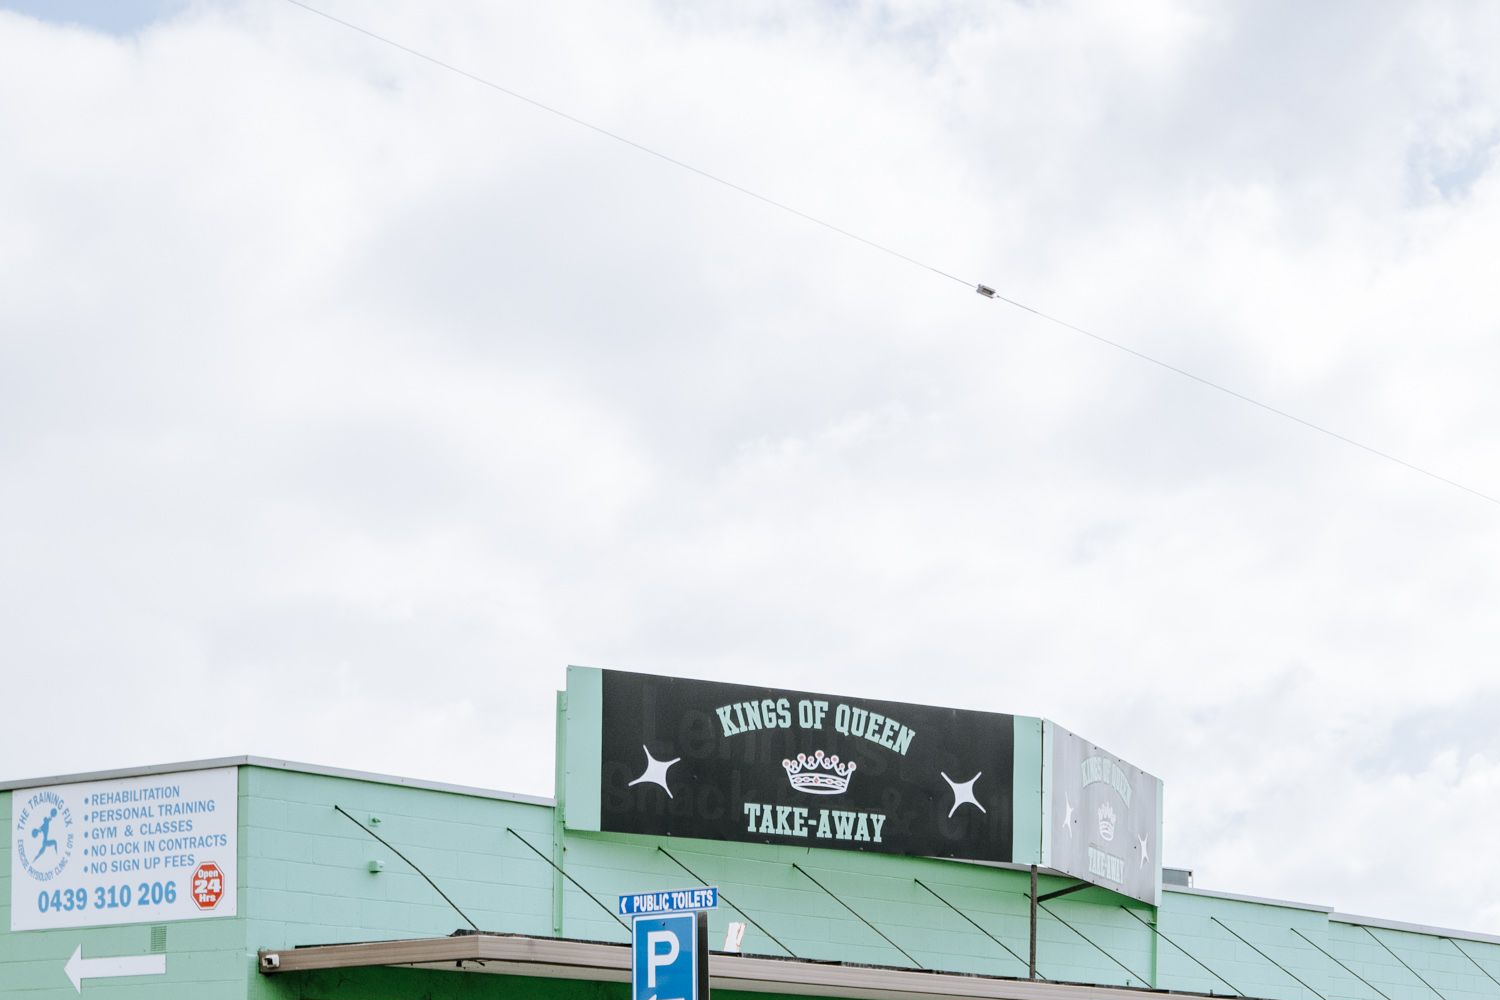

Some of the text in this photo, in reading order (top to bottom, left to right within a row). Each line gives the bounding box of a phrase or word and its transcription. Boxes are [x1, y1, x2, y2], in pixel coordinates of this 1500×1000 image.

[716, 698, 792, 737] KINGS
[799, 699, 829, 729] OF
[835, 703, 916, 757] QUEEN
[92, 786, 180, 805] REHABILITATION
[17, 791, 74, 831] THE TRAINING FIX
[92, 800, 215, 823] PERSONAL TRAINING
[744, 802, 886, 843] TAKE-AWAY
[92, 820, 193, 840] GYM & CLASSES
[91, 834, 227, 857] NO LOCK IN CONTRACTS
[91, 854, 195, 874] NO SIGN UP FEES
[197, 869, 218, 881] Open
[38, 881, 177, 913] 0439 310 206
[194, 878, 221, 894] 24
[199, 893, 216, 903] Hrs
[633, 889, 714, 912] PUBLIC TOILETS
[647, 930, 680, 988] P
